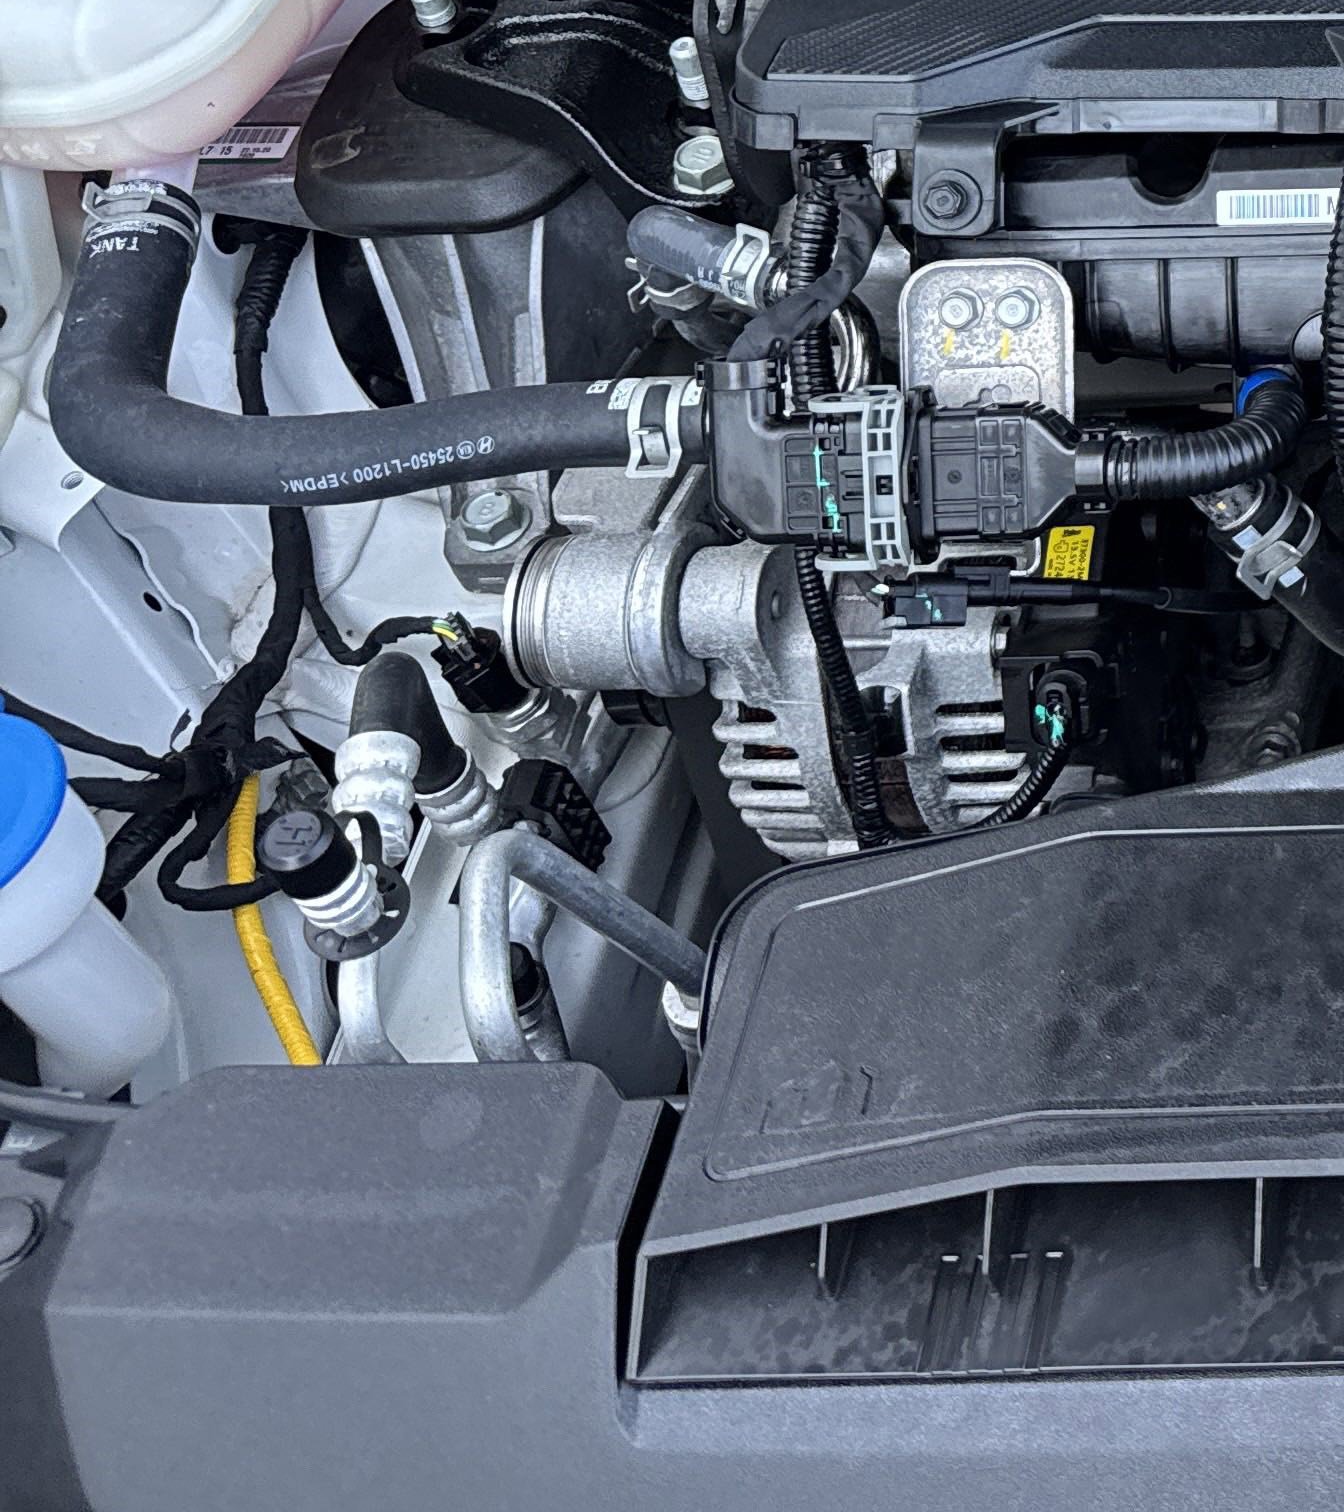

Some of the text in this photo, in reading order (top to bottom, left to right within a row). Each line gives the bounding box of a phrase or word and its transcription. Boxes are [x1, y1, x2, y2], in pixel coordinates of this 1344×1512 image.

[89, 236, 140, 259] TANK
[353, 446, 454, 484] 25450-L1200
[280, 472, 349, 494] >EPDM<
